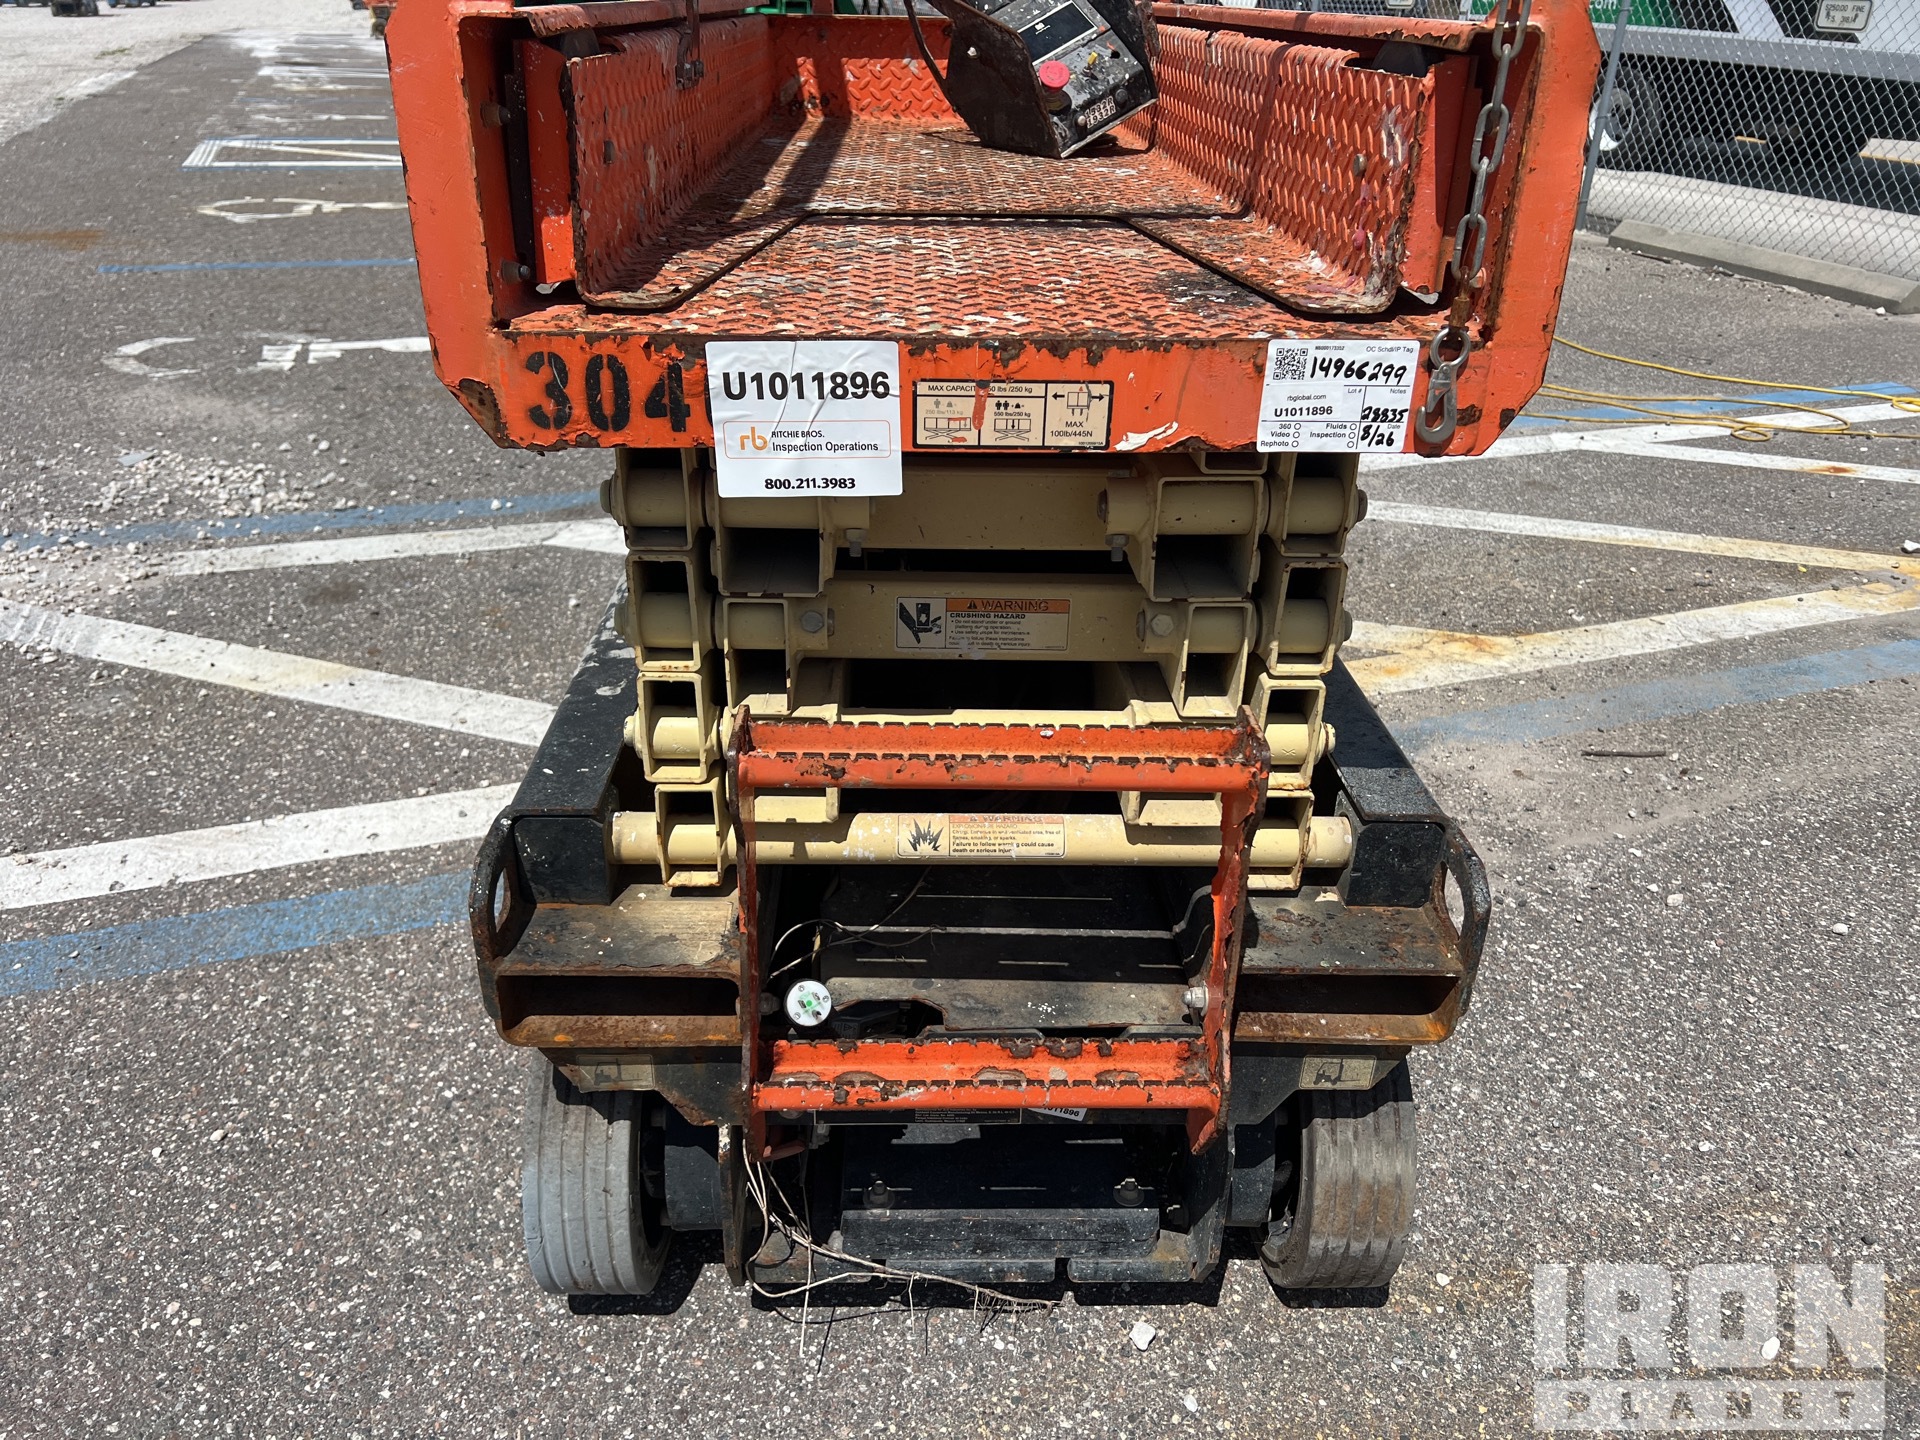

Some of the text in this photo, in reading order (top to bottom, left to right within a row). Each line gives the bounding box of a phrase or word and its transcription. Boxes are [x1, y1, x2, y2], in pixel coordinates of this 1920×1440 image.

[1852, 5, 1866, 13] FINE
[1088, 105, 1116, 127] 1932R
[1402, 346, 1414, 354] Tag
[1309, 356, 1408, 387] 14966299
[722, 371, 891, 401] U1011896
[928, 385, 944, 393] MAX
[1008, 387, 1023, 395] /250
[1024, 387, 1033, 395] kg
[525, 351, 714, 433] 304
[1287, 394, 1327, 402] rbglobal.com
[1023, 411, 1032, 419] kg
[1274, 406, 1333, 418] U1011896
[1325, 423, 1348, 431] Fluids
[1387, 423, 1401, 431] Date
[739, 426, 768, 451] rb
[770, 430, 825, 440] RITCHIE BROS.
[1050, 430, 1093, 438] 100lb/445N
[1270, 431, 1291, 439] Video
[1309, 430, 1347, 440] Inspection
[1360, 424, 1395, 448] 8/26
[771, 442, 879, 454] Inspection Operations
[1260, 439, 1290, 449] Rephoto
[764, 477, 857, 490] 800.211.3983
[981, 599, 1049, 611] WARNING
